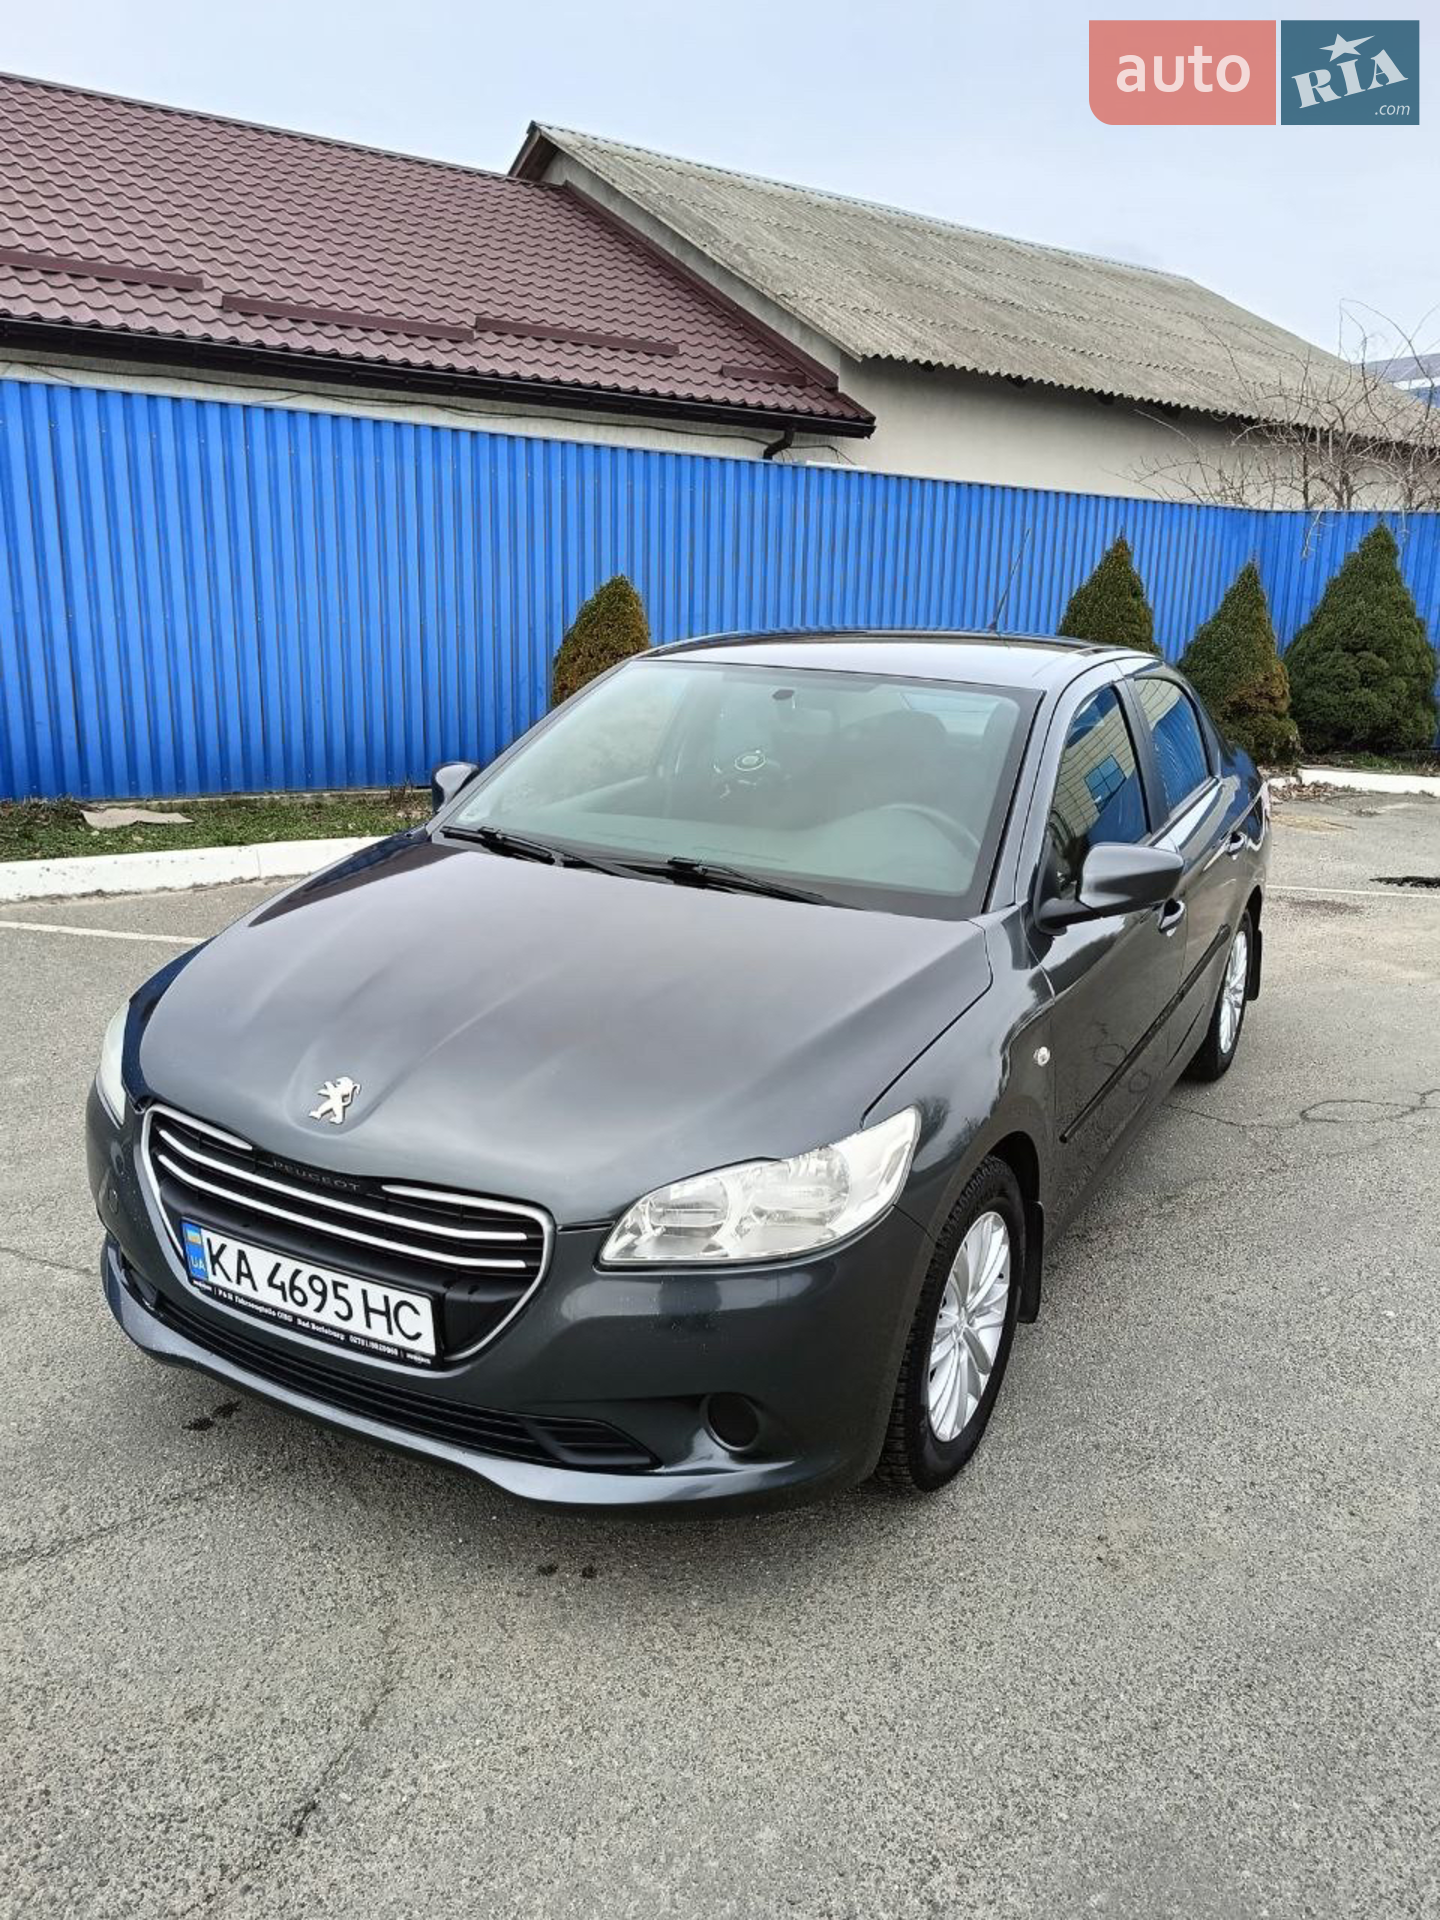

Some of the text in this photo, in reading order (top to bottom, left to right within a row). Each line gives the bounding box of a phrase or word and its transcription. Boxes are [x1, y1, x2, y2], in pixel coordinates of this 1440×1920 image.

[190, 1254, 206, 1272] UA
[206, 1237, 258, 1292] KA
[267, 1262, 353, 1322] 4695
[361, 1288, 422, 1341] HC
